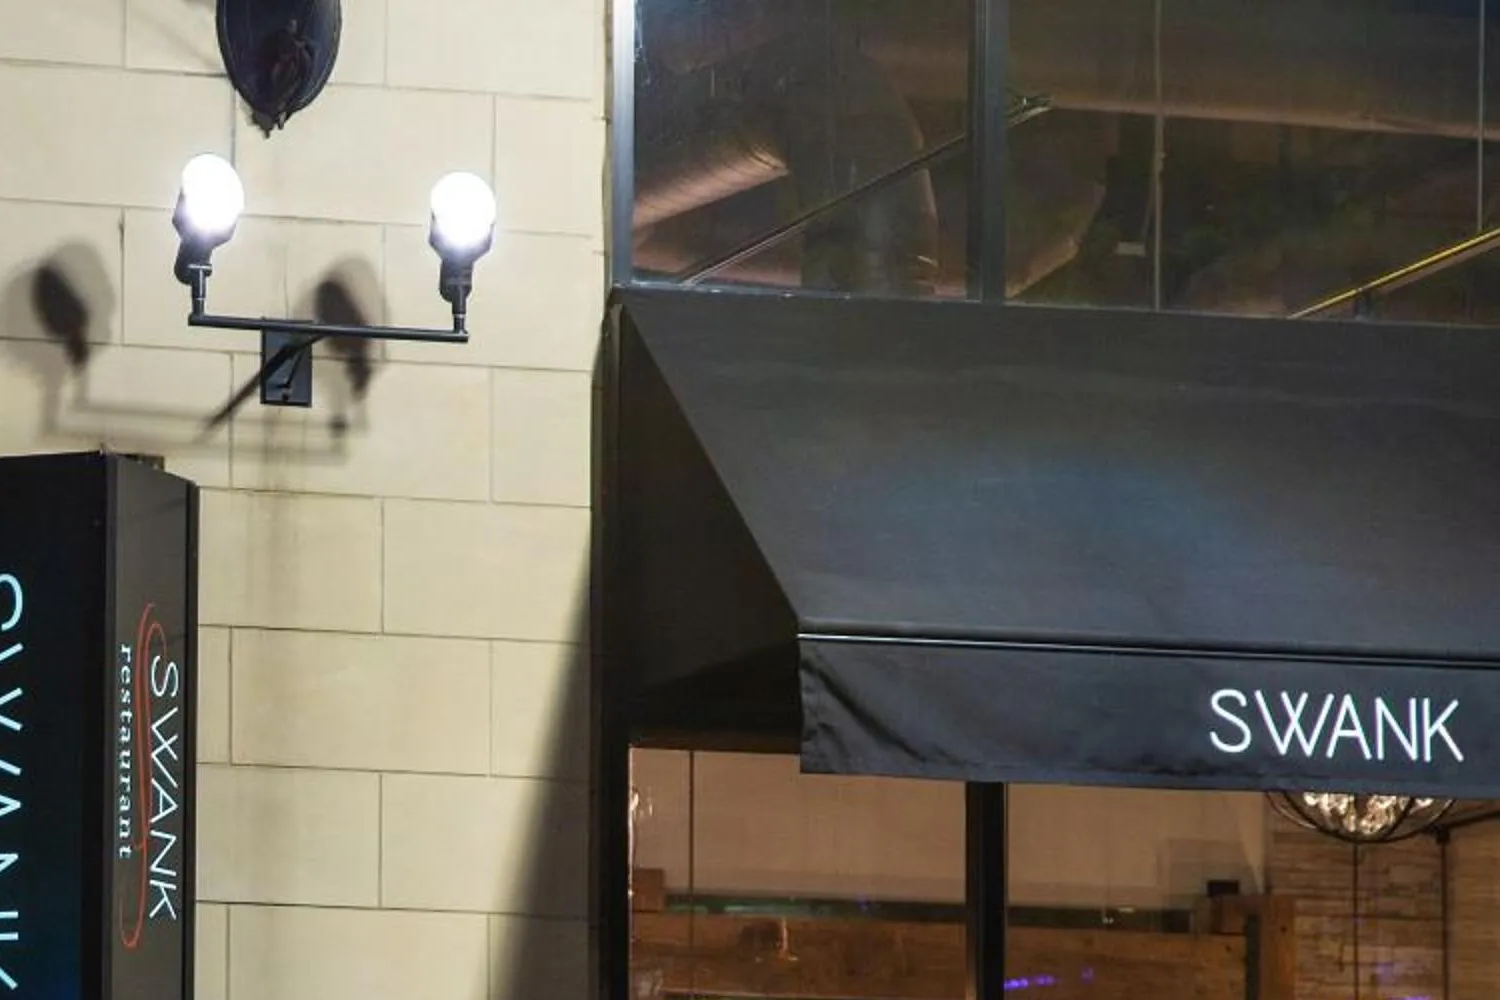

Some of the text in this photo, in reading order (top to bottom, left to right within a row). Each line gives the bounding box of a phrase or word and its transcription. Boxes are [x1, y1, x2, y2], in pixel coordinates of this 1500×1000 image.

[118, 643, 133, 858] restaurant
[150, 655, 179, 920] SWANK
[1209, 687, 1465, 764] SWANK
